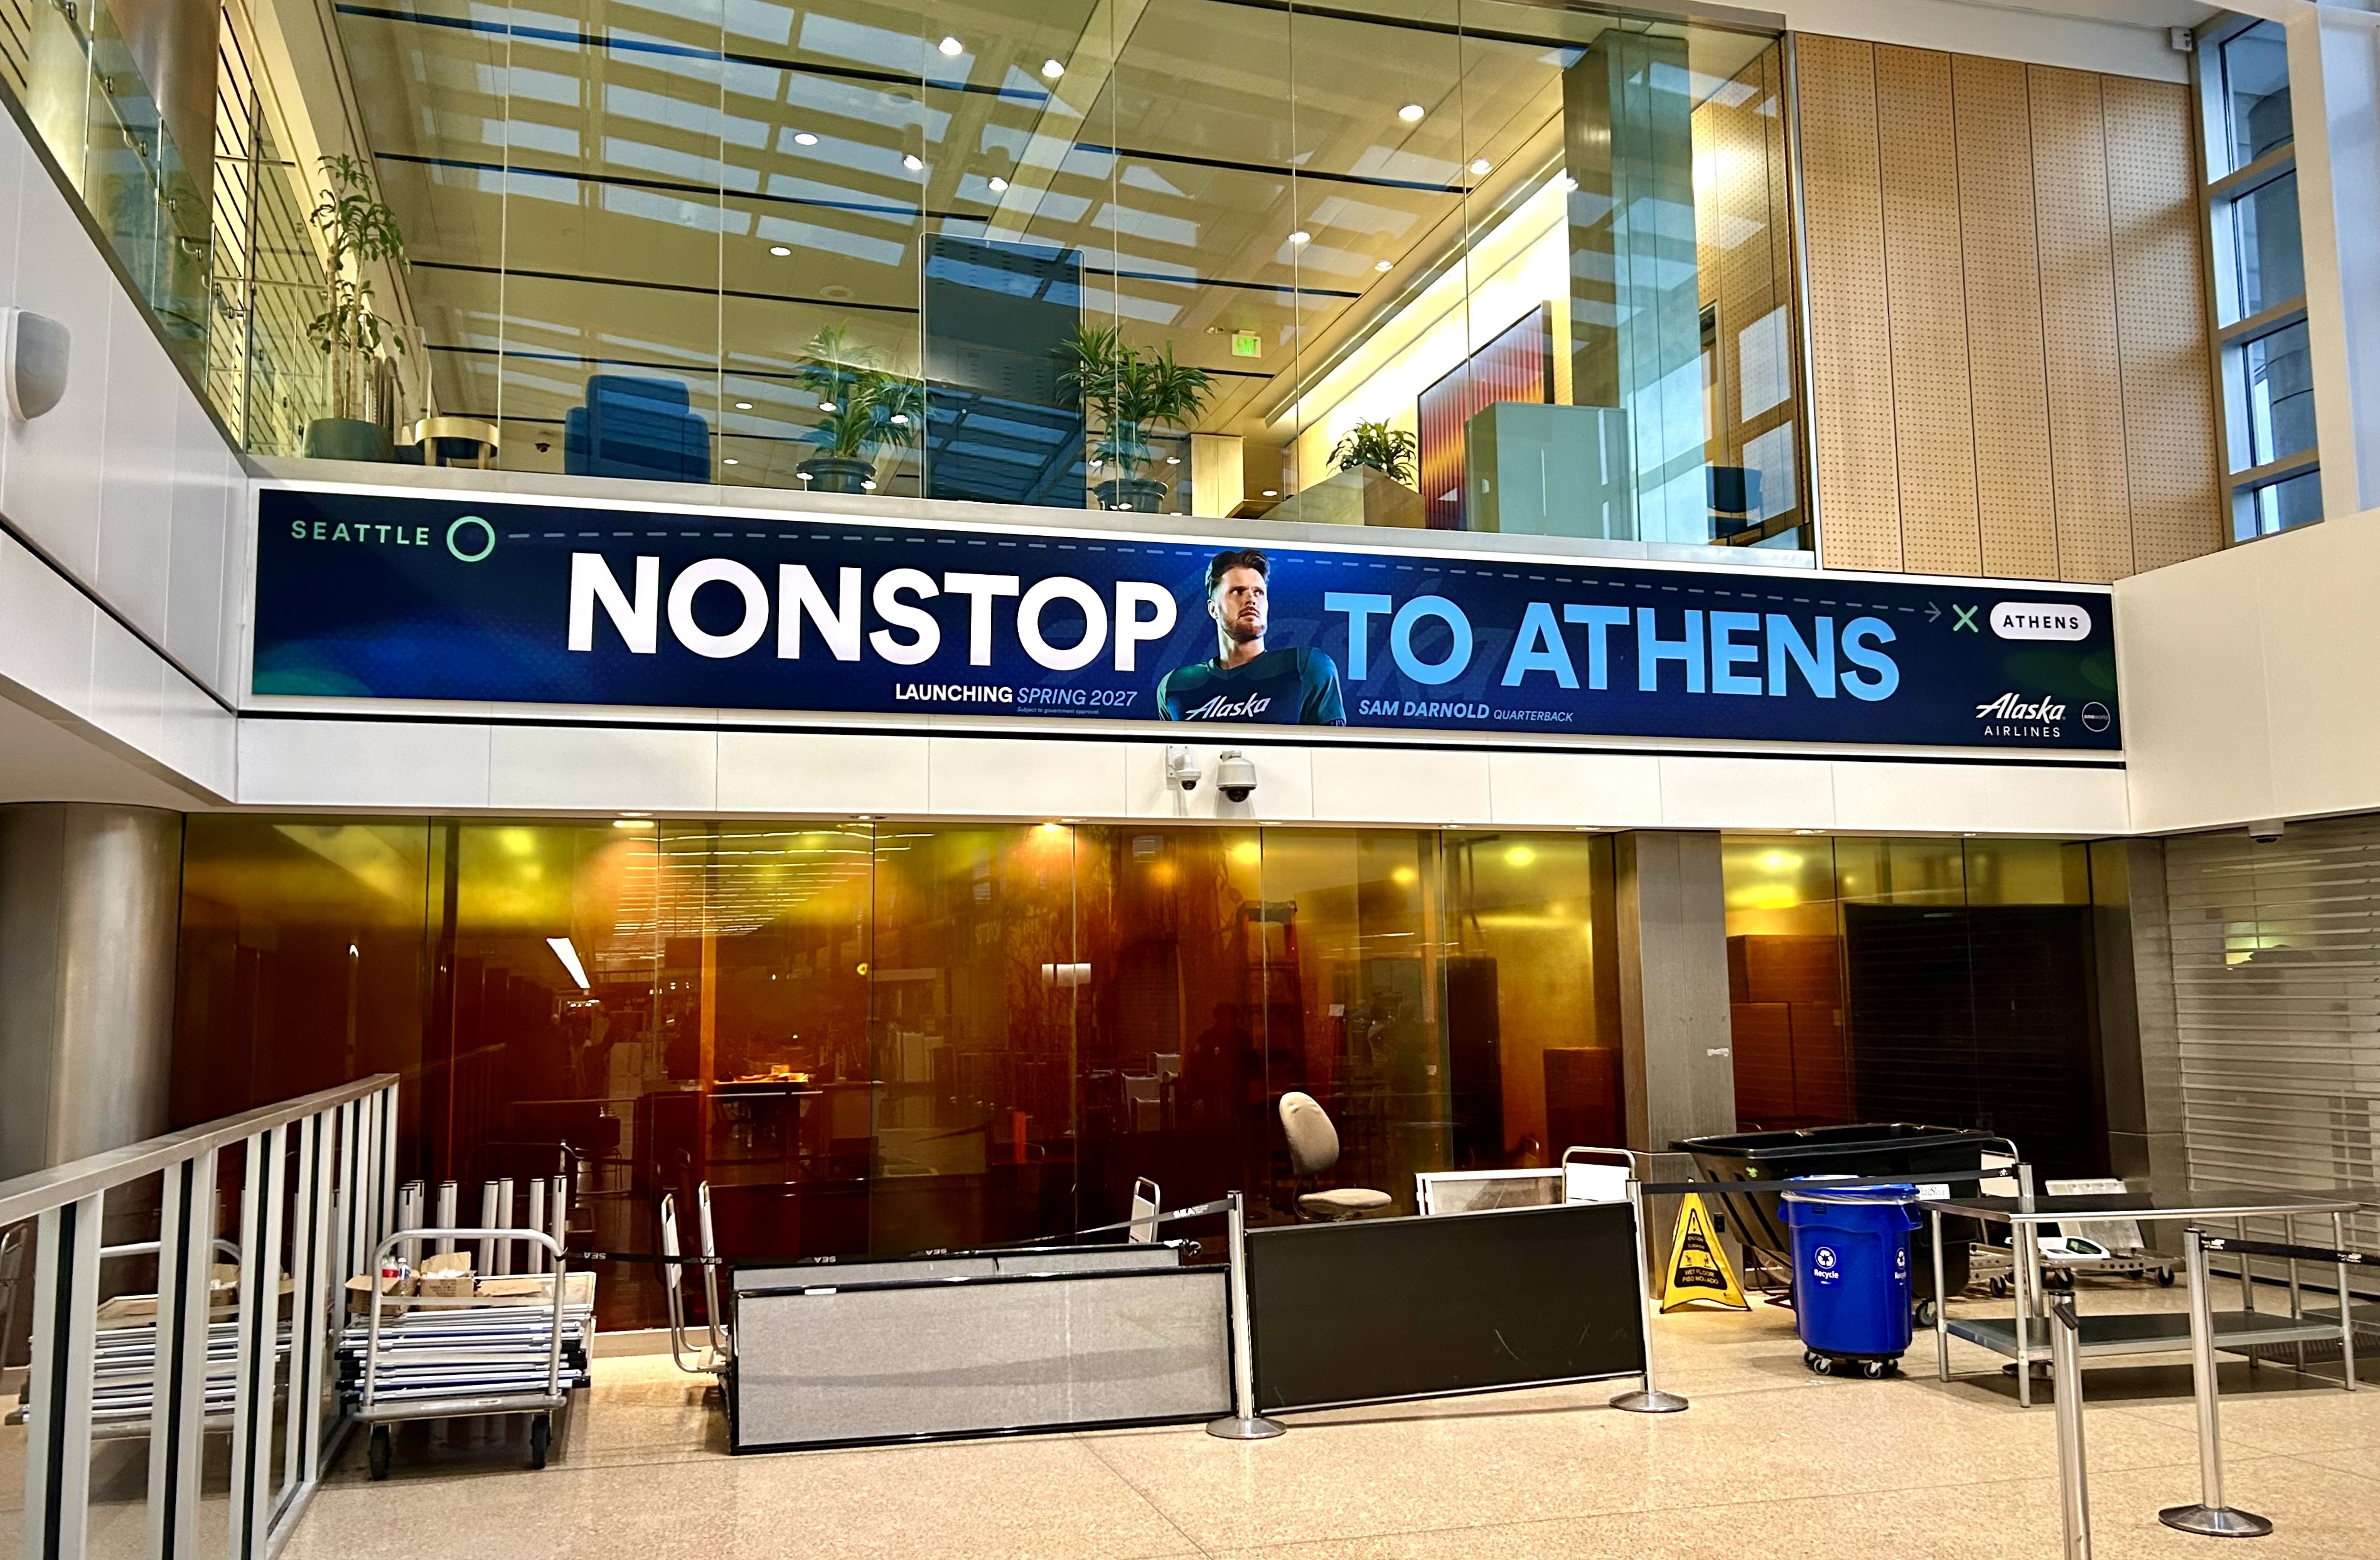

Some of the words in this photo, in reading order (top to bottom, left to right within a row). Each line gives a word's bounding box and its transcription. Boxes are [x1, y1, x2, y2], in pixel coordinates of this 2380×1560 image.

[1235, 336, 1258, 355] EXIT
[291, 520, 429, 545] SEATTLE
[568, 552, 1178, 672] NONSTOP
[1324, 592, 1473, 685] TO
[1501, 602, 1900, 702] ATHENS
[2003, 614, 2079, 629] ATHENS
[896, 683, 1012, 703] LAUNCHING
[1017, 687, 1086, 705] SPRING
[1090, 690, 1138, 707] 2027
[1185, 692, 1271, 720] Alaska
[1358, 700, 1400, 716] SAM
[1403, 701, 1489, 719] DARNOLD
[1493, 709, 1574, 722] QUARTERBACK
[1976, 692, 2066, 724] Alaska
[1984, 725, 2061, 737] AIRLINES
[1172, 1207, 1196, 1219] SEA
[583, 1251, 606, 1260] SEA
[699, 1256, 722, 1264] SEA
[1696, 1268, 1715, 1277] FLOOR
[1813, 1268, 1840, 1279] Recycle
